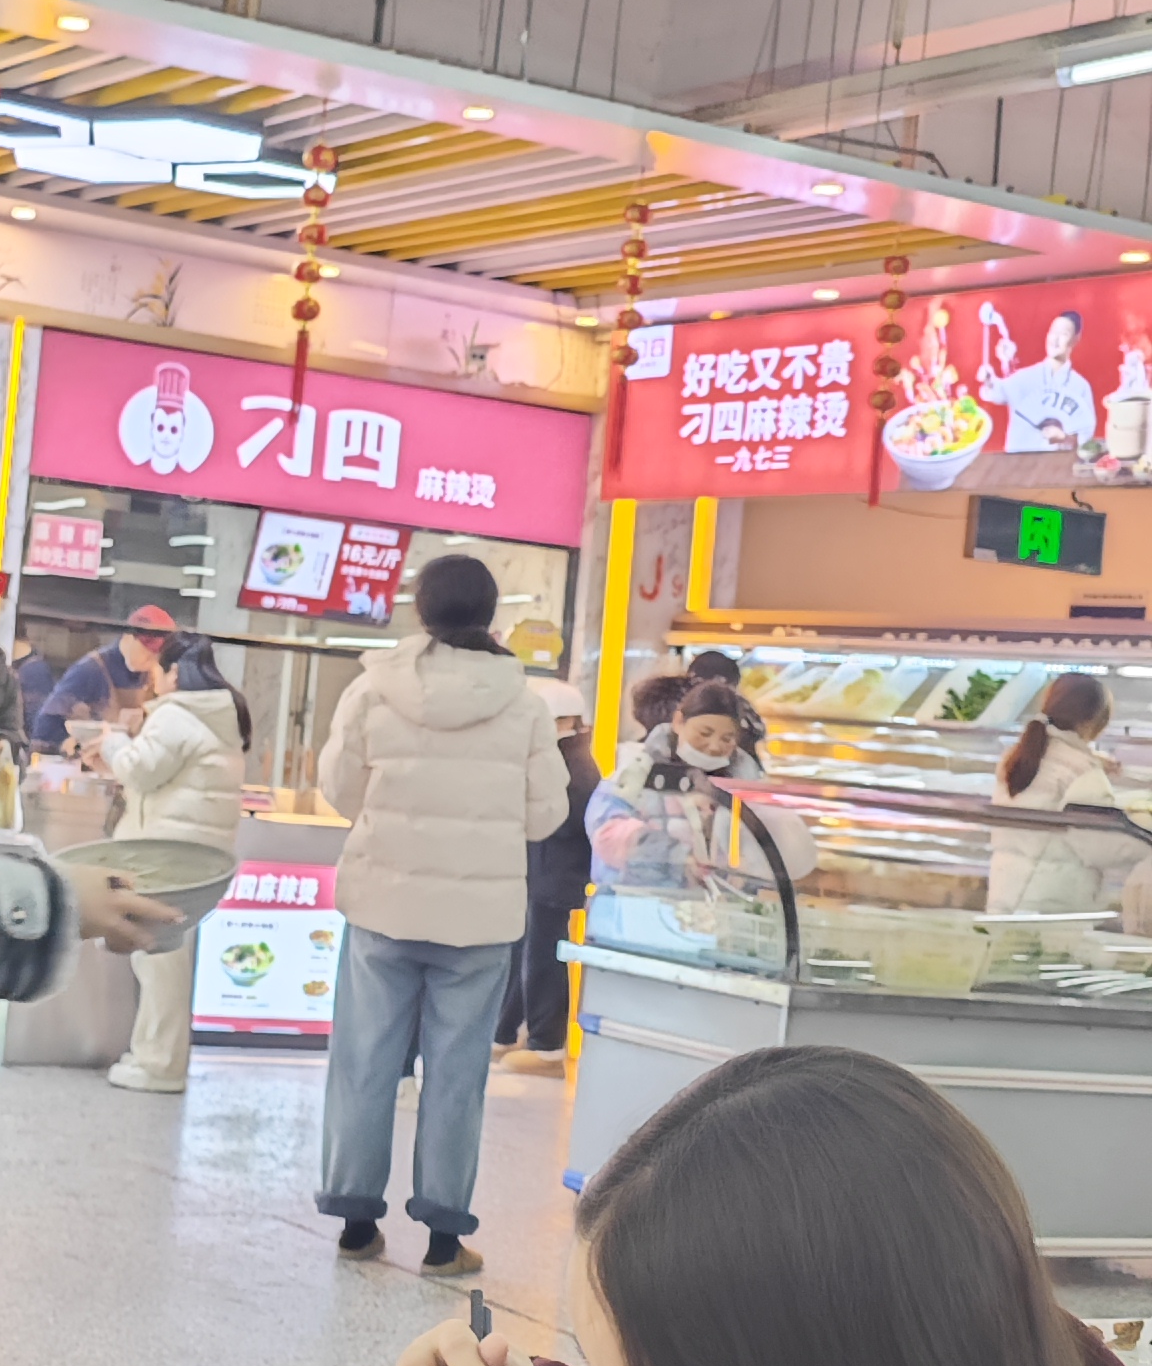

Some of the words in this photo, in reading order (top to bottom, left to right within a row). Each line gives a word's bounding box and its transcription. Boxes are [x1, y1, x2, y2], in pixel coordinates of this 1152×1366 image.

[681, 339, 855, 398] 好吃又不贵
[237, 395, 402, 489] 刁四
[679, 390, 850, 445] 刁四麻辣烫
[714, 445, 794, 472] 一九七三
[415, 466, 496, 509] 麻辣烫
